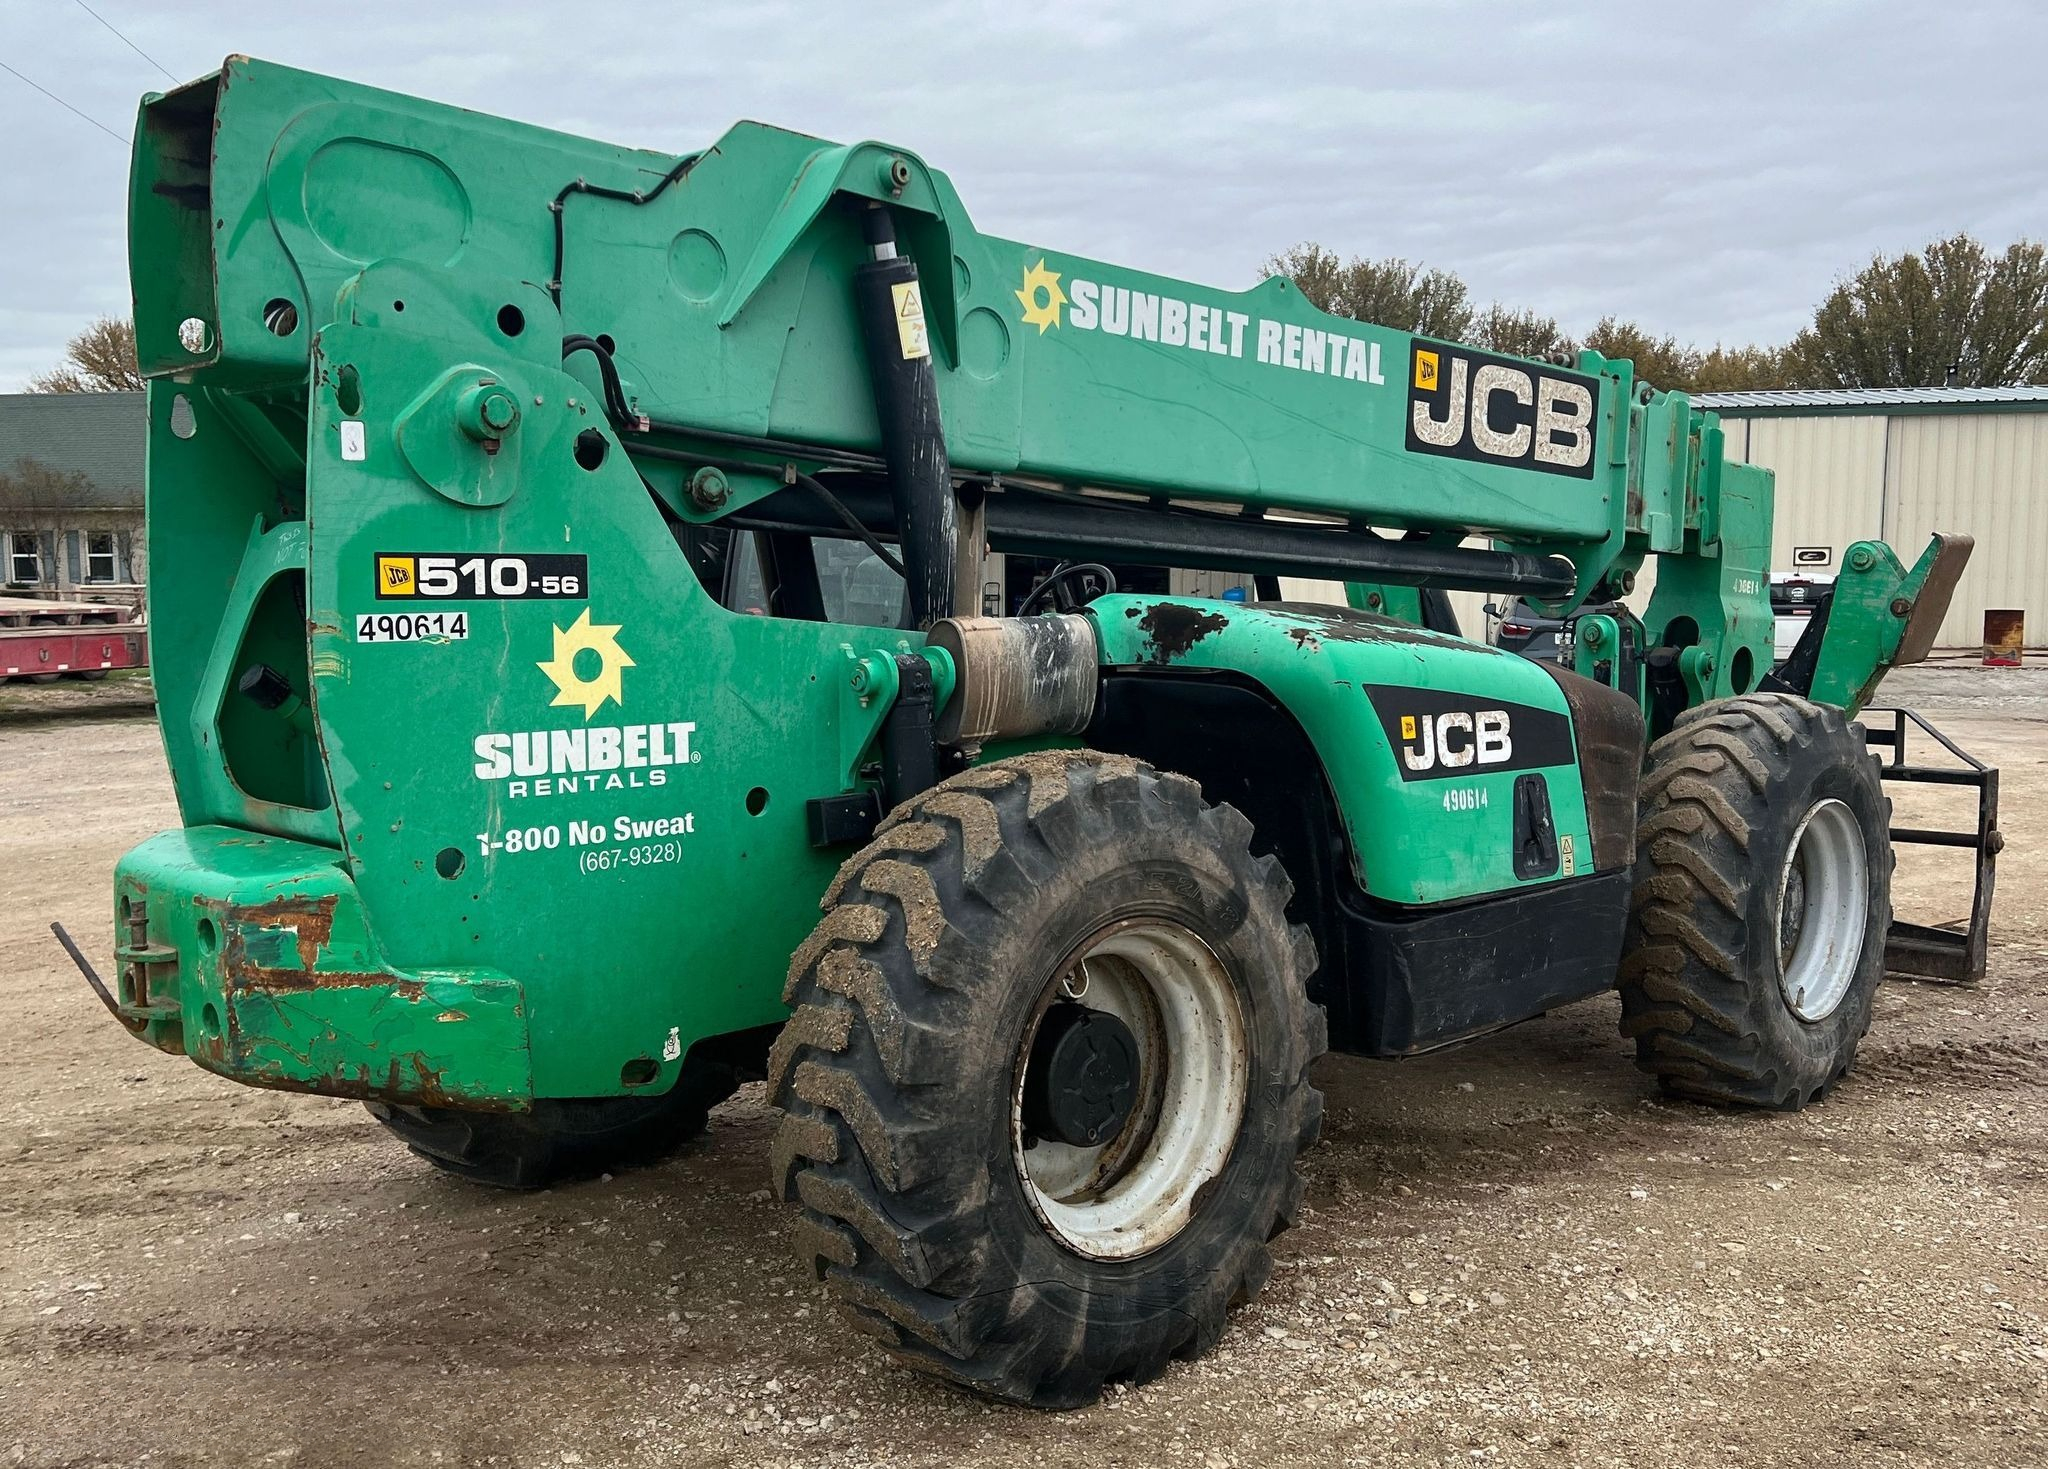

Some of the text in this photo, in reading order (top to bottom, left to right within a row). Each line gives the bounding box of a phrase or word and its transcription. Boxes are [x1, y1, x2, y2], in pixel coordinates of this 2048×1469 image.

[1069, 278, 1385, 386] SUNBELT RENTAL
[1413, 356, 1593, 468] JCB
[388, 567, 409, 585] JCB
[418, 557, 579, 596] 510-56
[358, 612, 467, 641] 490614
[1403, 709, 1513, 771] JCB
[508, 769, 667, 799] RENTALS
[1443, 787, 1488, 812] 490614
[476, 812, 695, 856] 1-800 No Sweat
[579, 841, 683, 875] (667-9328)
